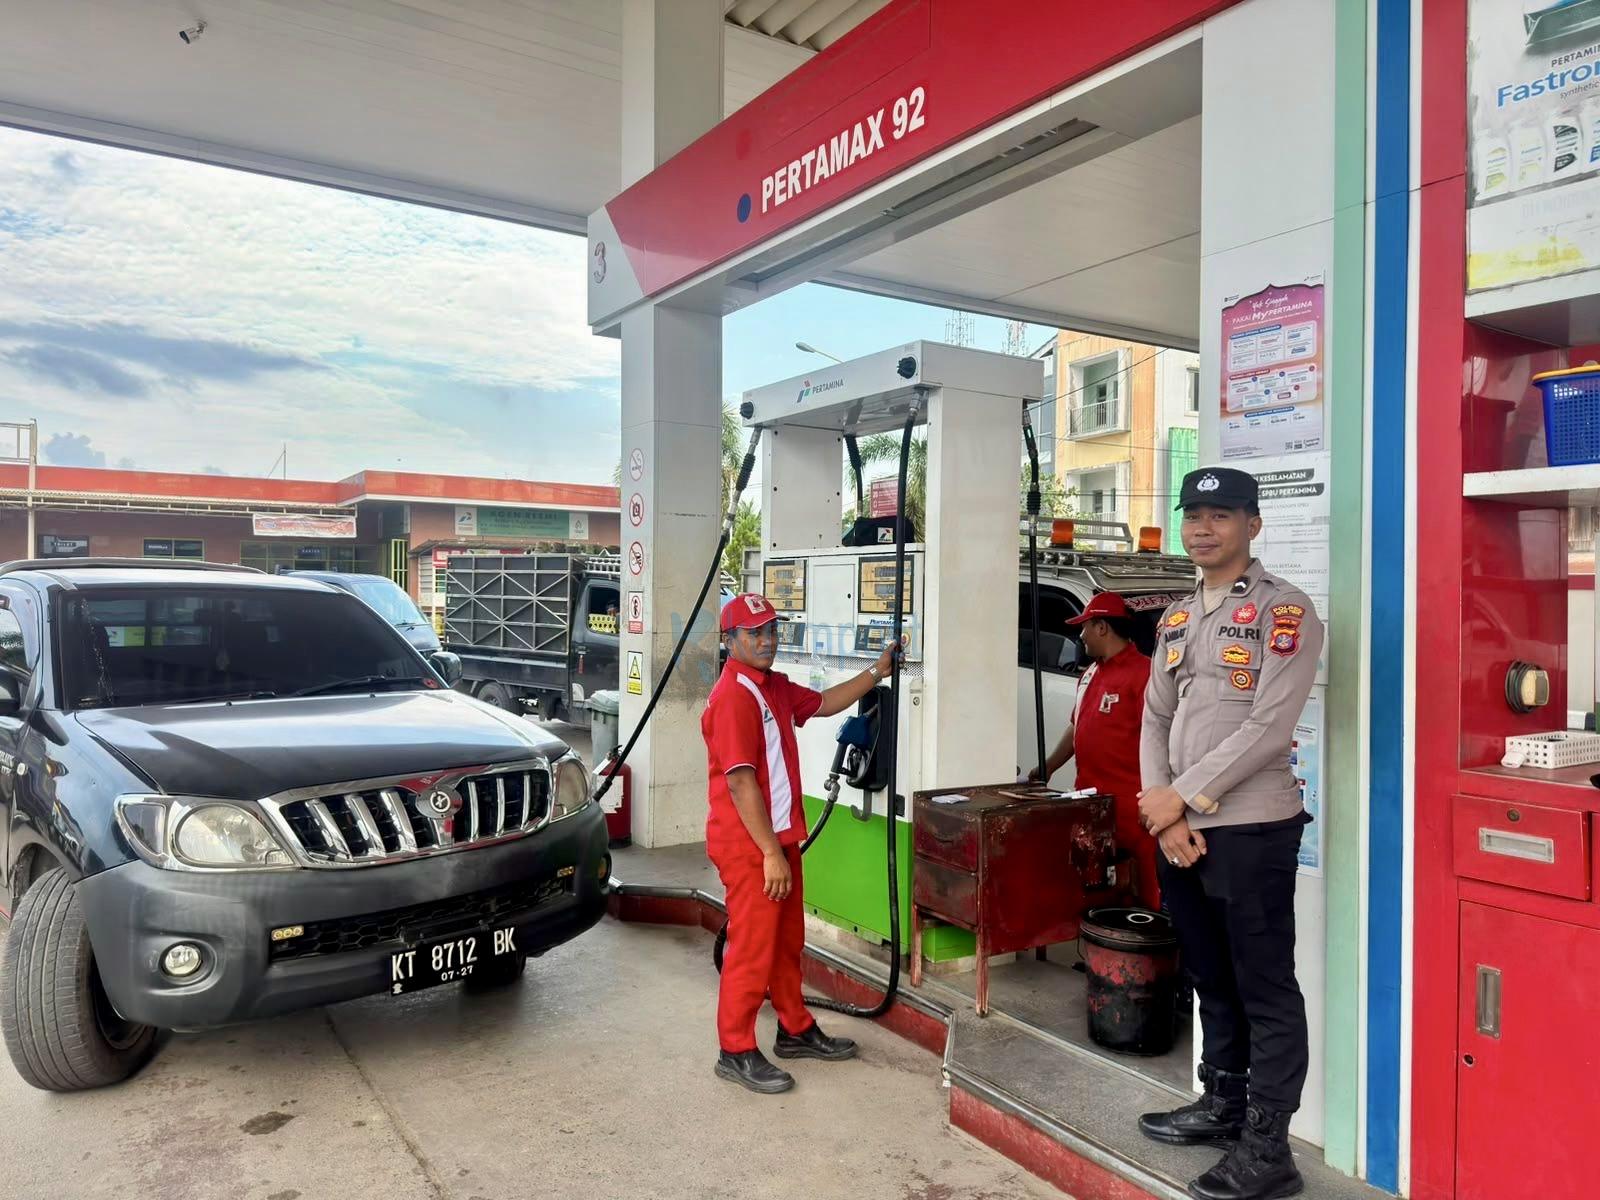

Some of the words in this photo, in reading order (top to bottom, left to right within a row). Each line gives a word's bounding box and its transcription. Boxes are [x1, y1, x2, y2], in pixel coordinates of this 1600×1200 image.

[1497, 60, 1600, 107] Fastro
[761, 108, 885, 214] PERTAMAX
[892, 85, 926, 141] 92
[593, 240, 608, 285] 3
[812, 378, 844, 395] PERTAMINA
[1259, 472, 1307, 483] KESELAMATAN
[1262, 488, 1279, 497] SPBU
[1279, 486, 1318, 497] PERTAMINA
[1217, 625, 1260, 641] POLRI
[391, 951, 417, 981] KT
[431, 936, 478, 972] 8712
[493, 926, 517, 956] BK
